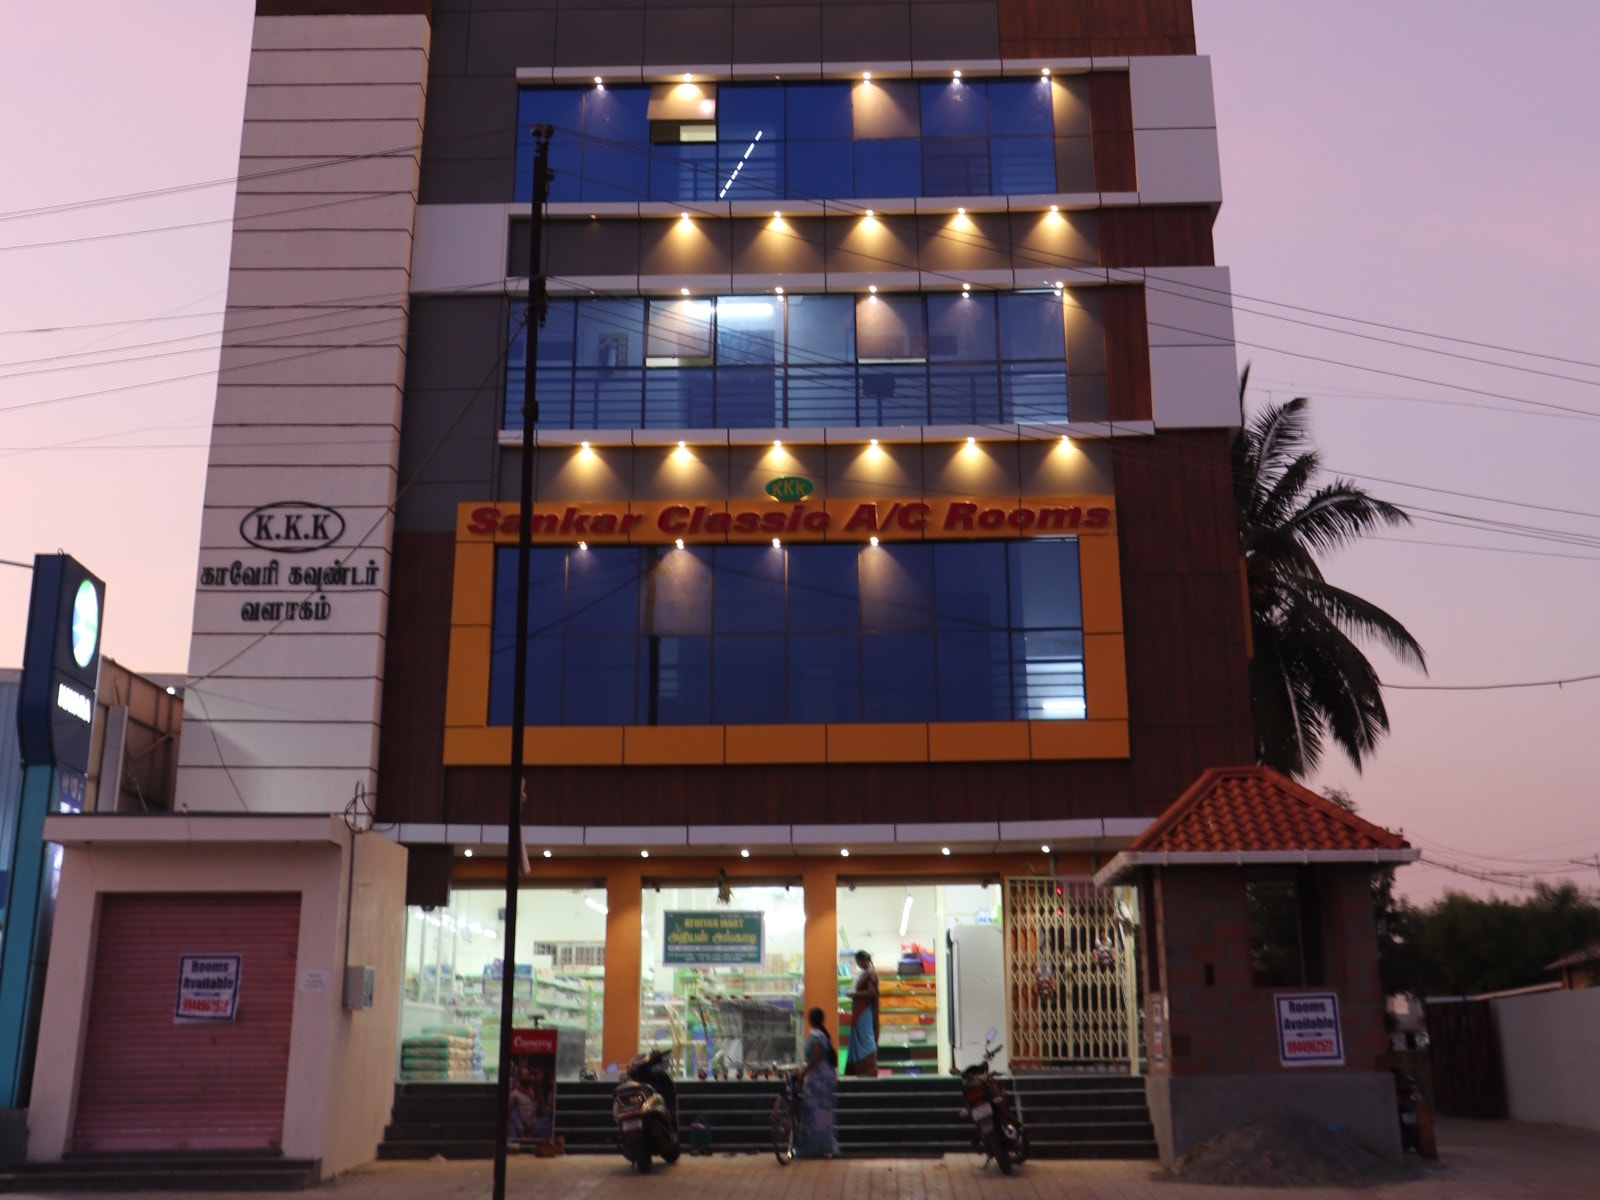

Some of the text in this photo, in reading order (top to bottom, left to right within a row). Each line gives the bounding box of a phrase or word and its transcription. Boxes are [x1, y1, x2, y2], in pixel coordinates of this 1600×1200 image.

[254, 513, 331, 541] K.K.K
[467, 500, 1110, 536] Sankar Classic A/C Rooms
[200, 558, 380, 592] காவேரி கவுண்டர்
[241, 595, 331, 621] வளாகம்
[191, 960, 230, 973] Rooms
[183, 976, 234, 989] Available
[1288, 1000, 1327, 1013] Rooms
[1284, 1016, 1335, 1030] Available
